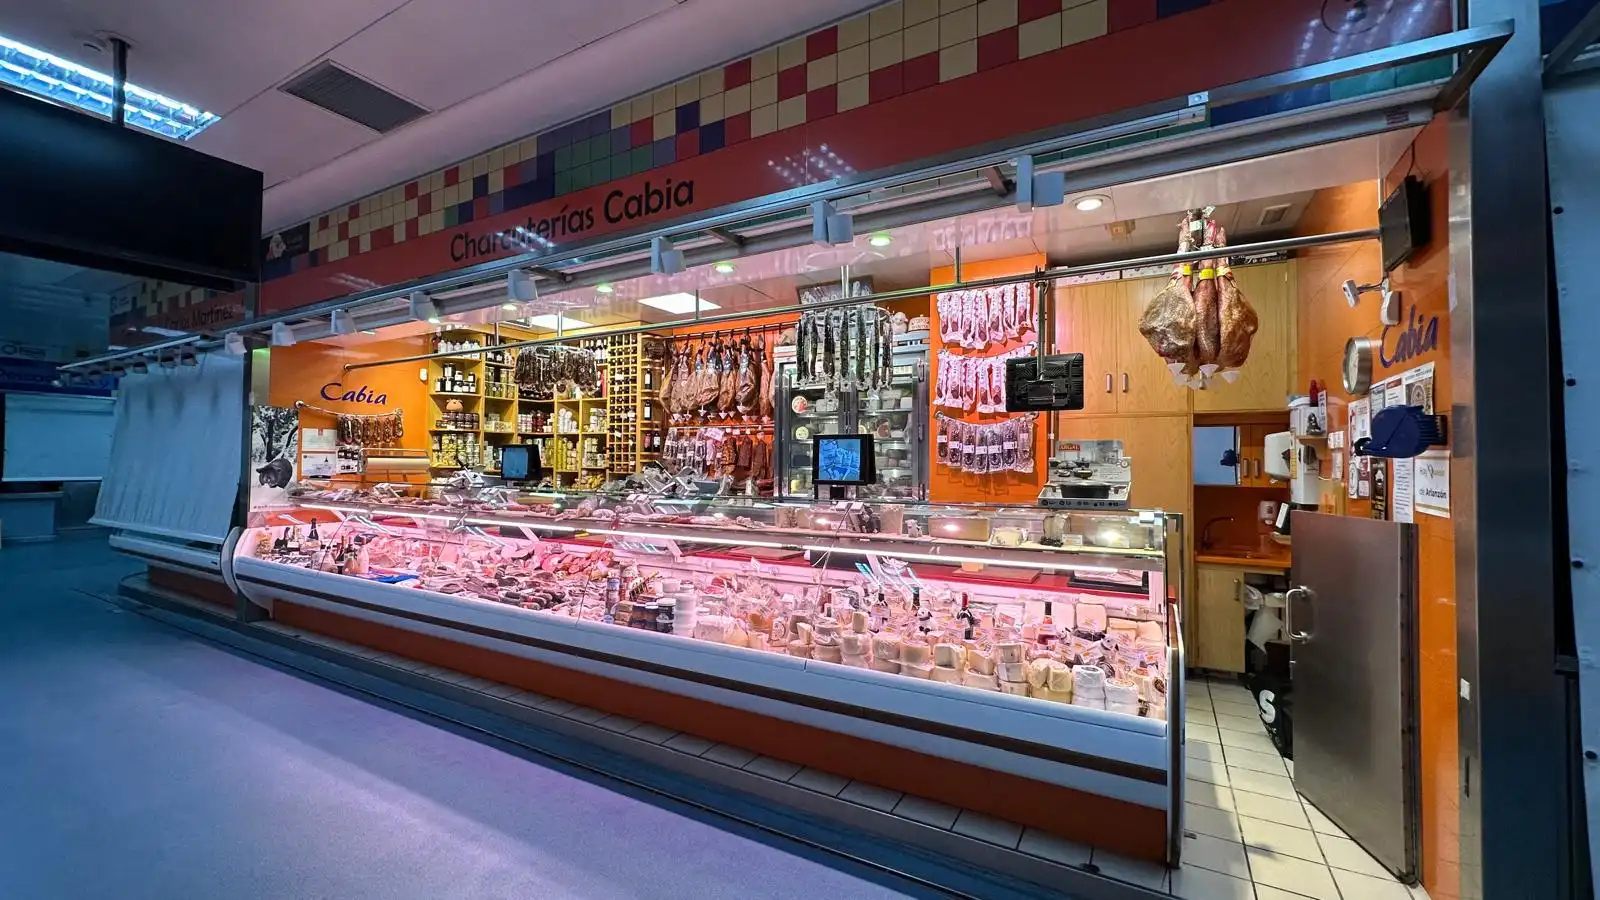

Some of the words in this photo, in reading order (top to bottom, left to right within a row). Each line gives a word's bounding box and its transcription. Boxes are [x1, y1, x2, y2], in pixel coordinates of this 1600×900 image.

[450, 204, 594, 262] Charcuterías
[604, 179, 694, 224] Cabia
[1379, 304, 1439, 369] Cabia
[320, 382, 387, 406] Cabia
[1259, 689, 1276, 724] S
